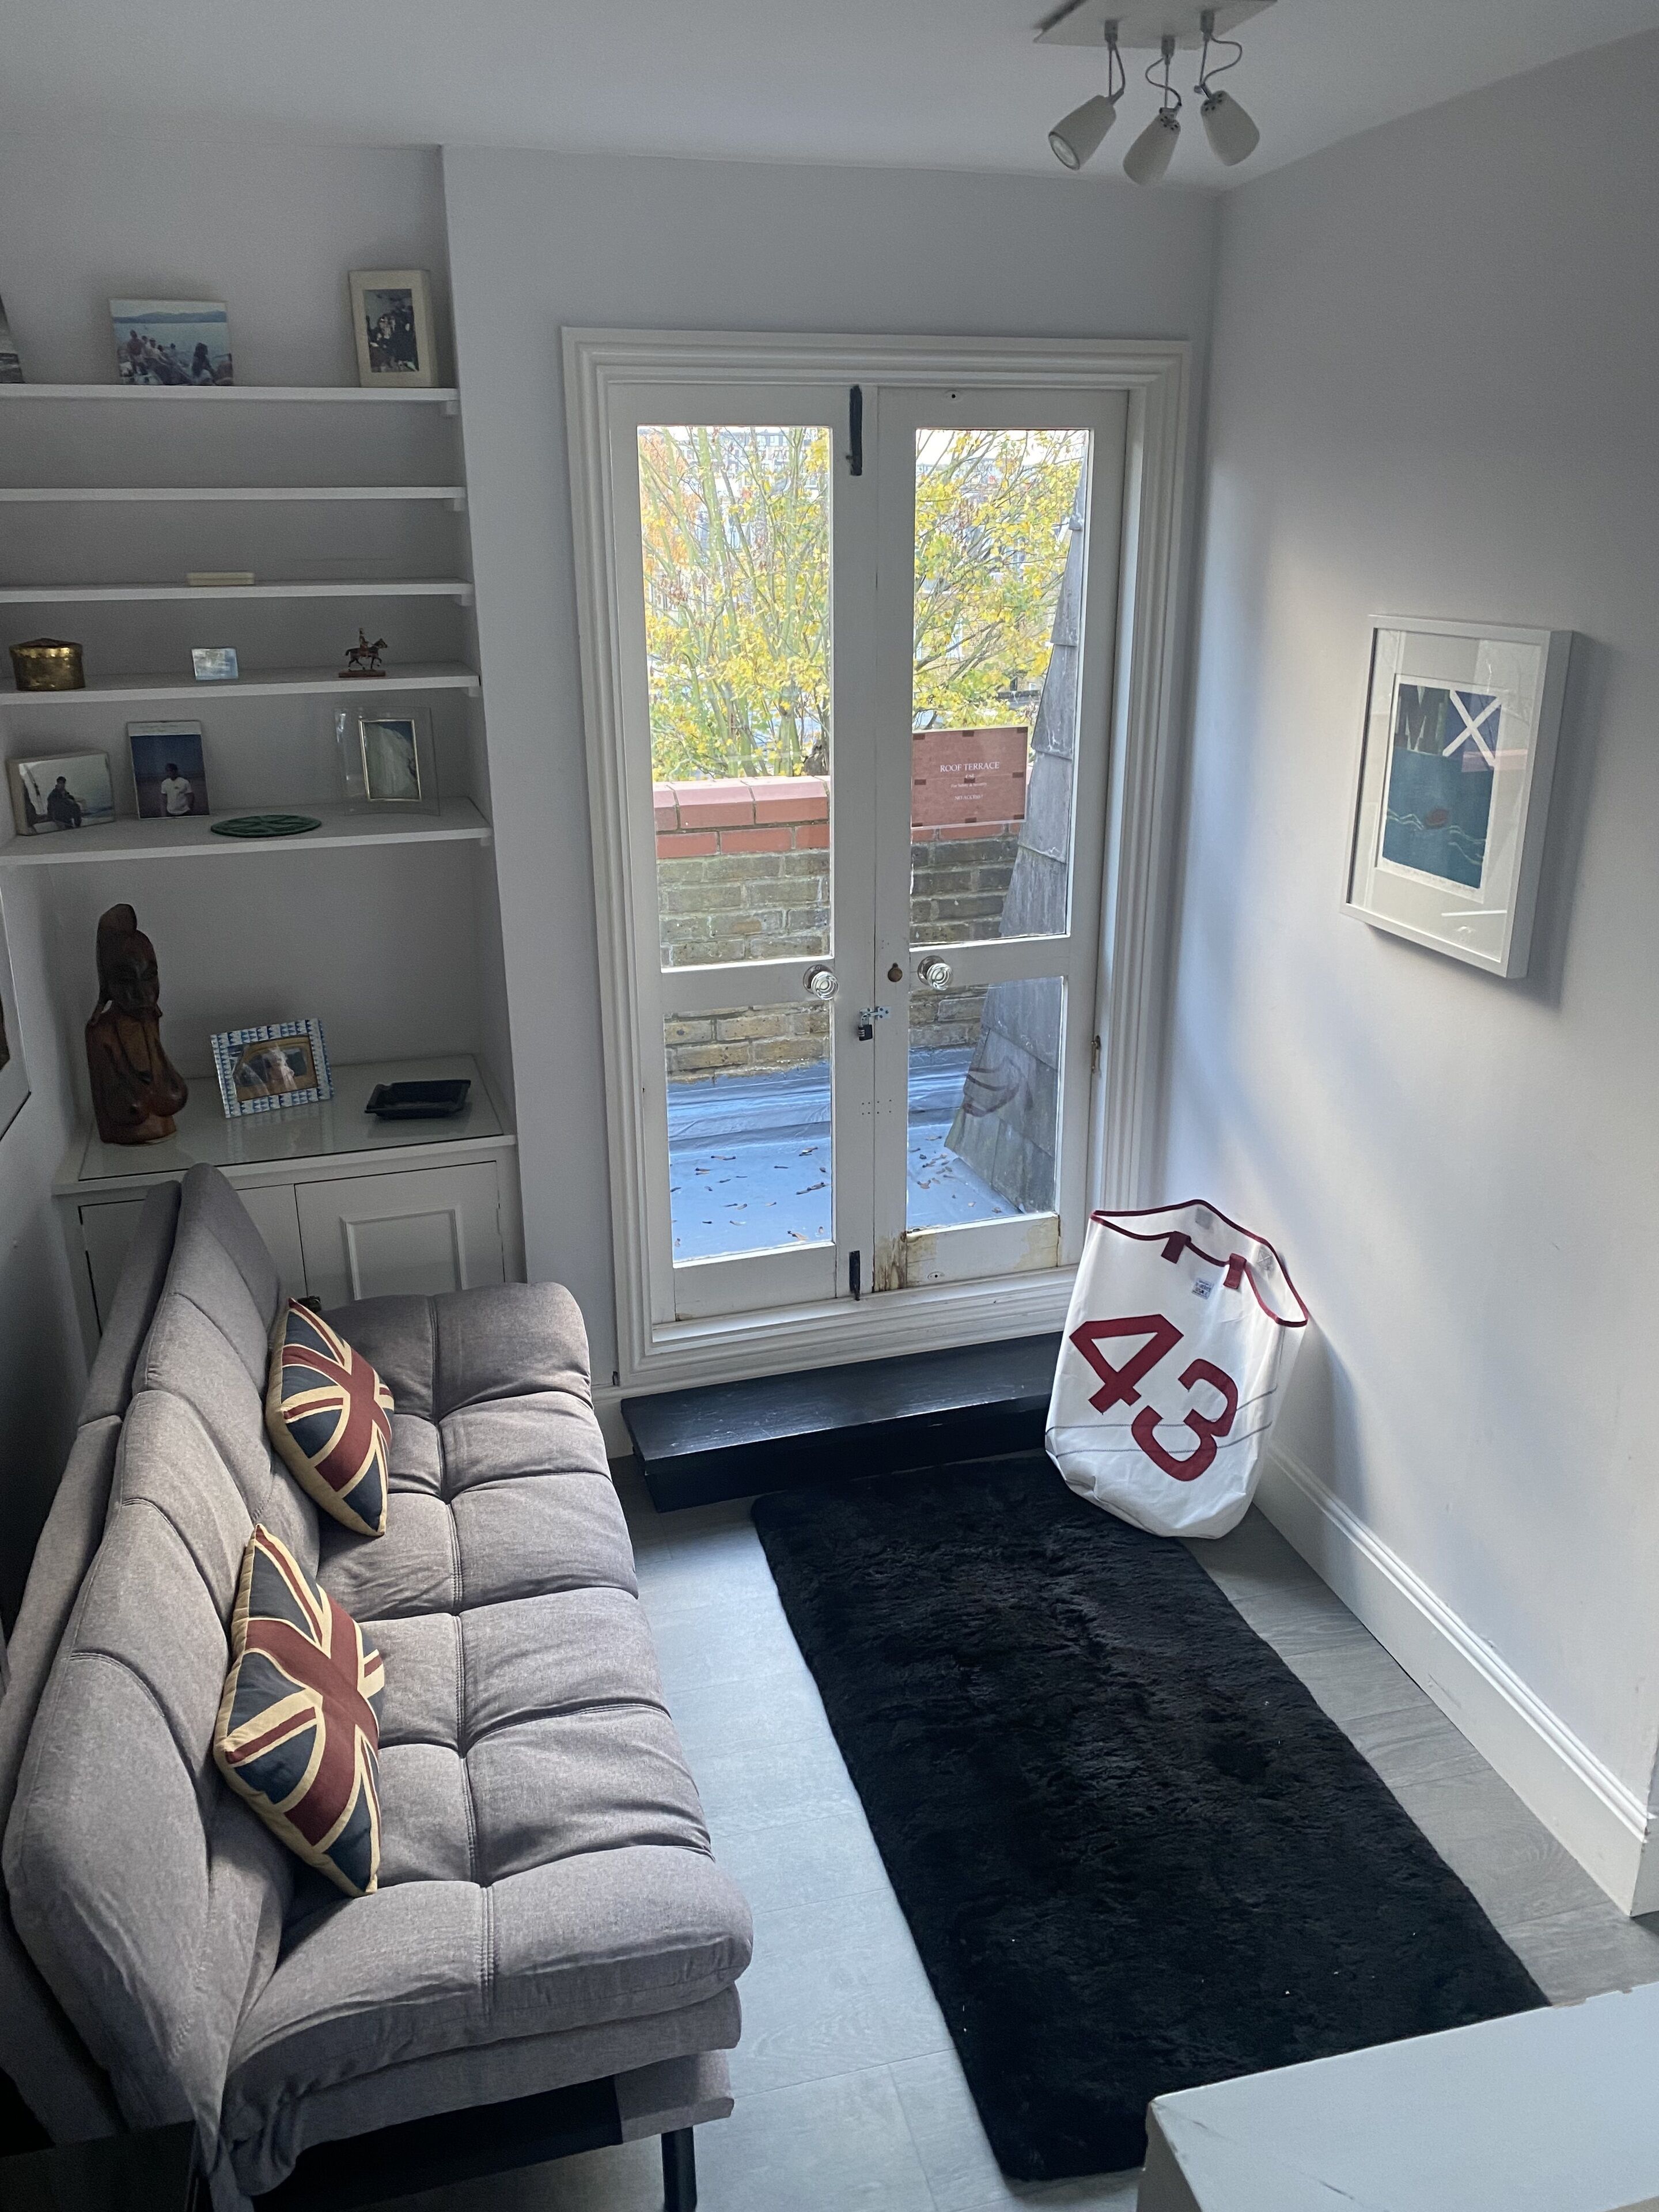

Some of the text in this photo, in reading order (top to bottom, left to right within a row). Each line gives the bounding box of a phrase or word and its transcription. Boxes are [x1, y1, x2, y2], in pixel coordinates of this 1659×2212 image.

[940, 762, 1000, 772] ROOF TERRACE
[1069, 1314, 1238, 1482] 43
